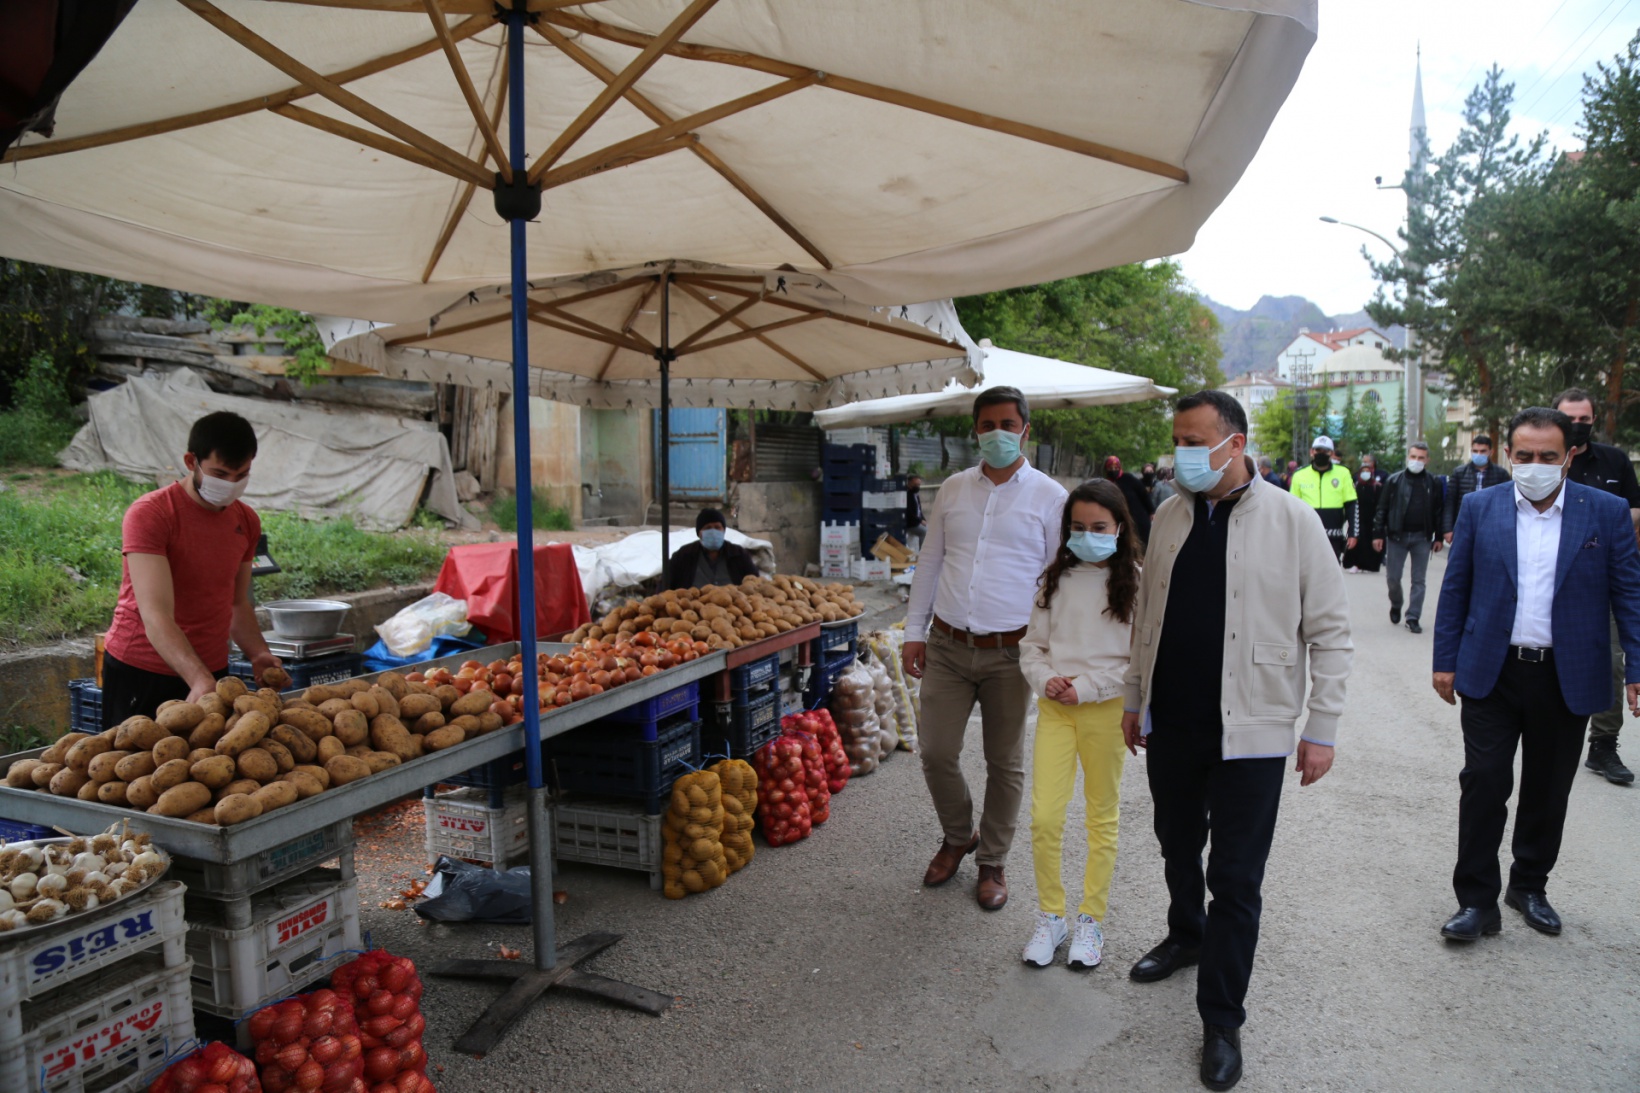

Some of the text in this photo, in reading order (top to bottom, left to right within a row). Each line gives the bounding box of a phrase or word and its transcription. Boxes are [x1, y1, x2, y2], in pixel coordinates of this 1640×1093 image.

[439, 820, 485, 833] ATIF
[278, 911, 328, 944] ATIF
[46, 1010, 163, 1078] ATIF
